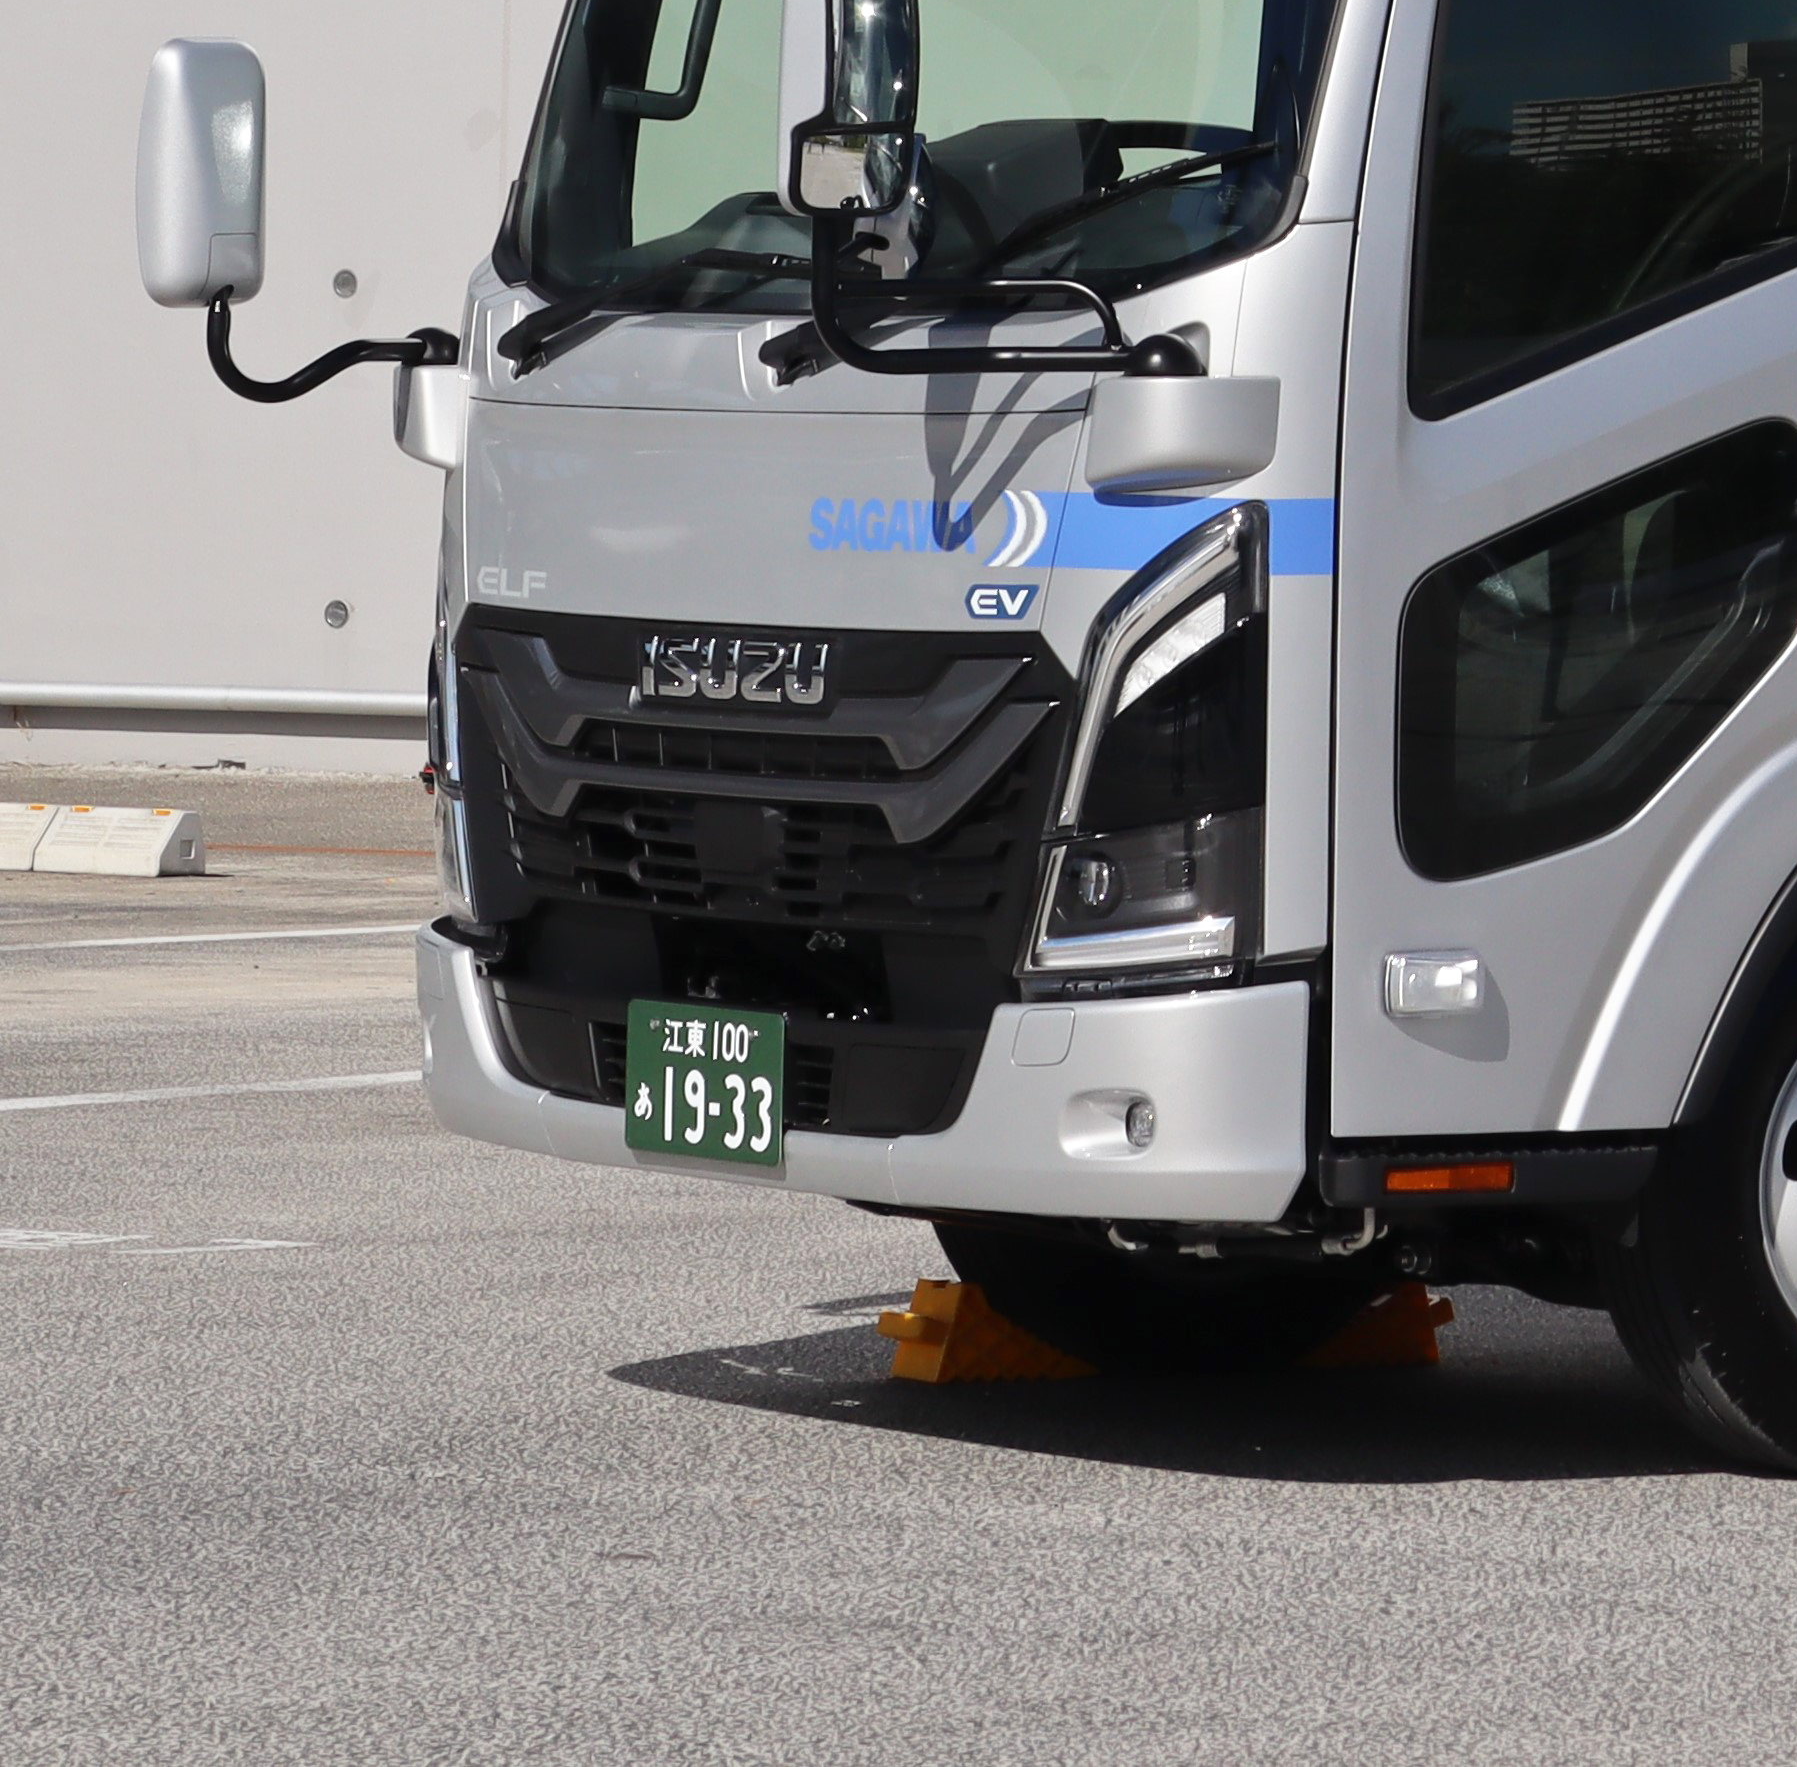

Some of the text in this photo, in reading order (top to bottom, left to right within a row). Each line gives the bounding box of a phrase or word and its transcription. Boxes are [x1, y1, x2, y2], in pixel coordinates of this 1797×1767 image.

[808, 497, 976, 554] SAGAWA
[477, 566, 547, 598] ELF
[970, 589, 1029, 615] EV
[641, 635, 828, 705] ISUZU
[663, 1019, 749, 1063] 江東 100
[634, 1082, 653, 1120] あ
